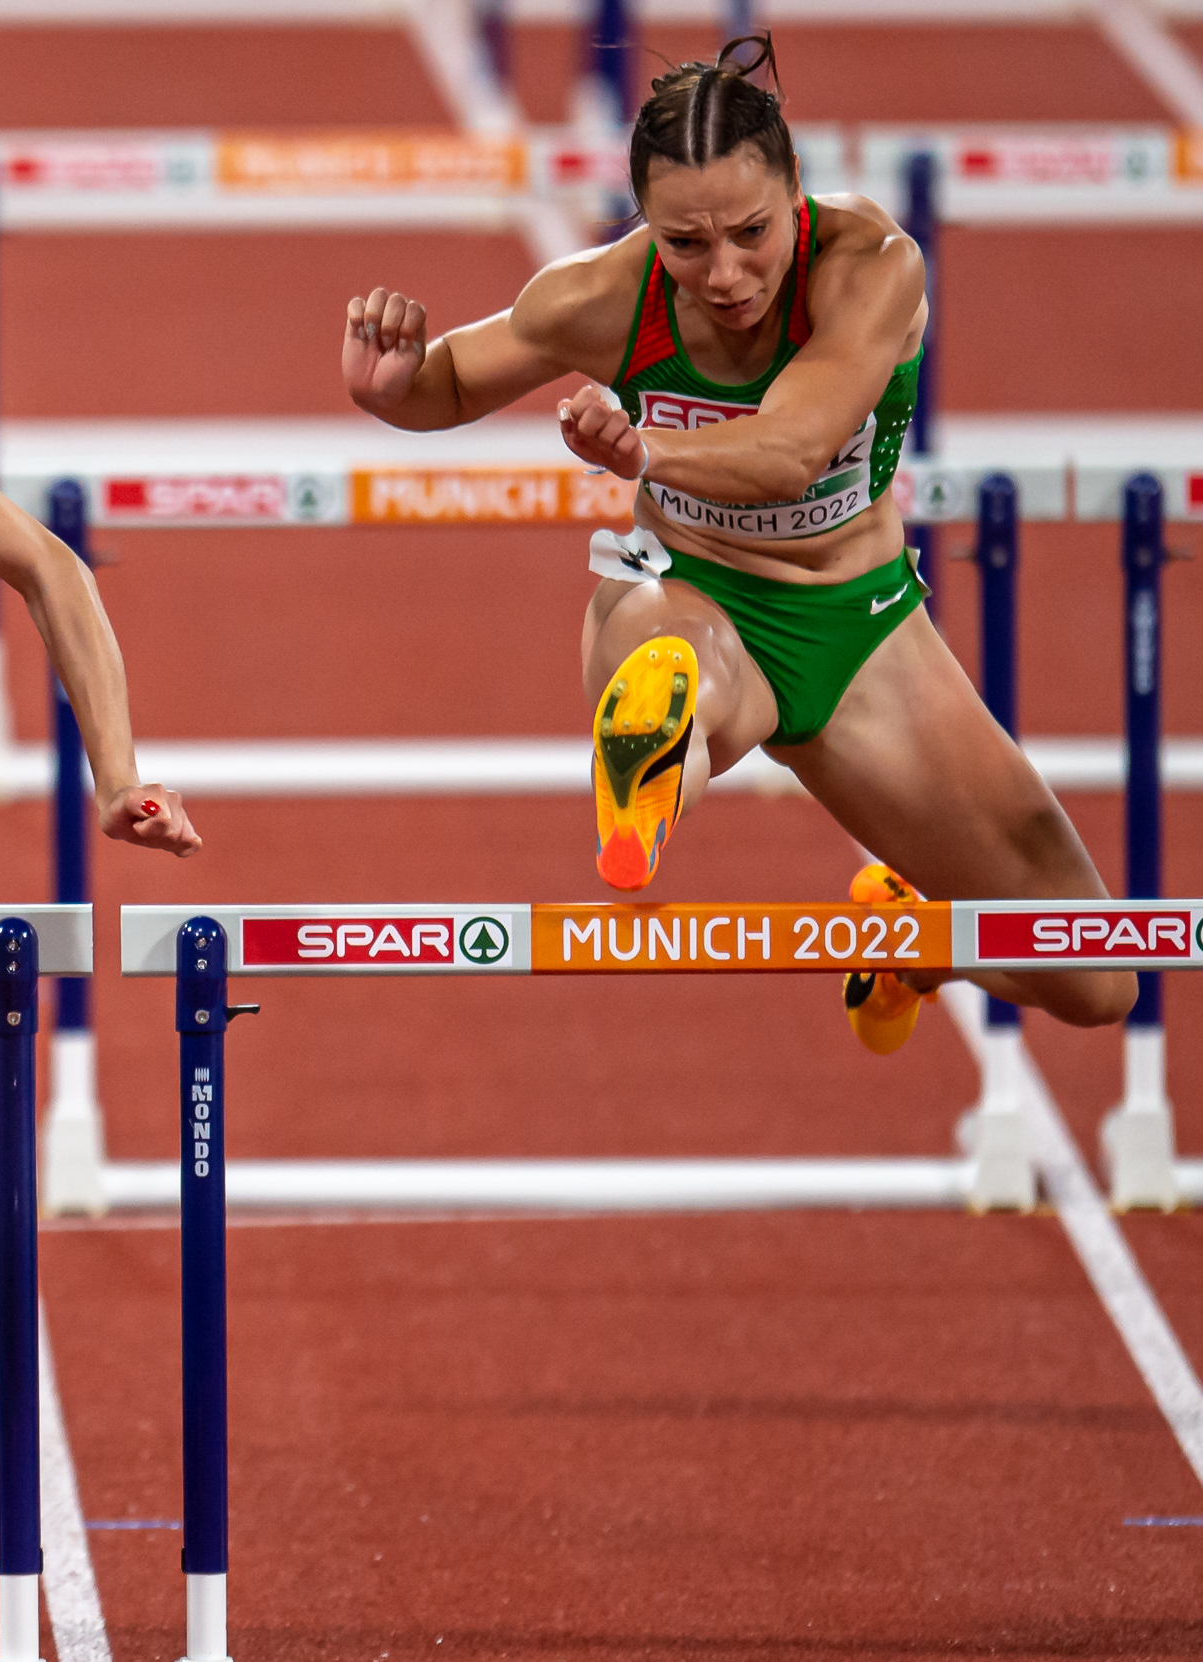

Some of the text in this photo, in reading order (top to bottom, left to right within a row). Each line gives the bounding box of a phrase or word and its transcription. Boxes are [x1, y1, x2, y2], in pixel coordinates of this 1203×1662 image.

[661, 489, 777, 533] MUNICH
[791, 491, 858, 531] 2022
[297, 915, 921, 962] SPAR MUNICH 2022
[1033, 917, 1186, 952] SPAR
[192, 1085, 212, 1177] MONDO
